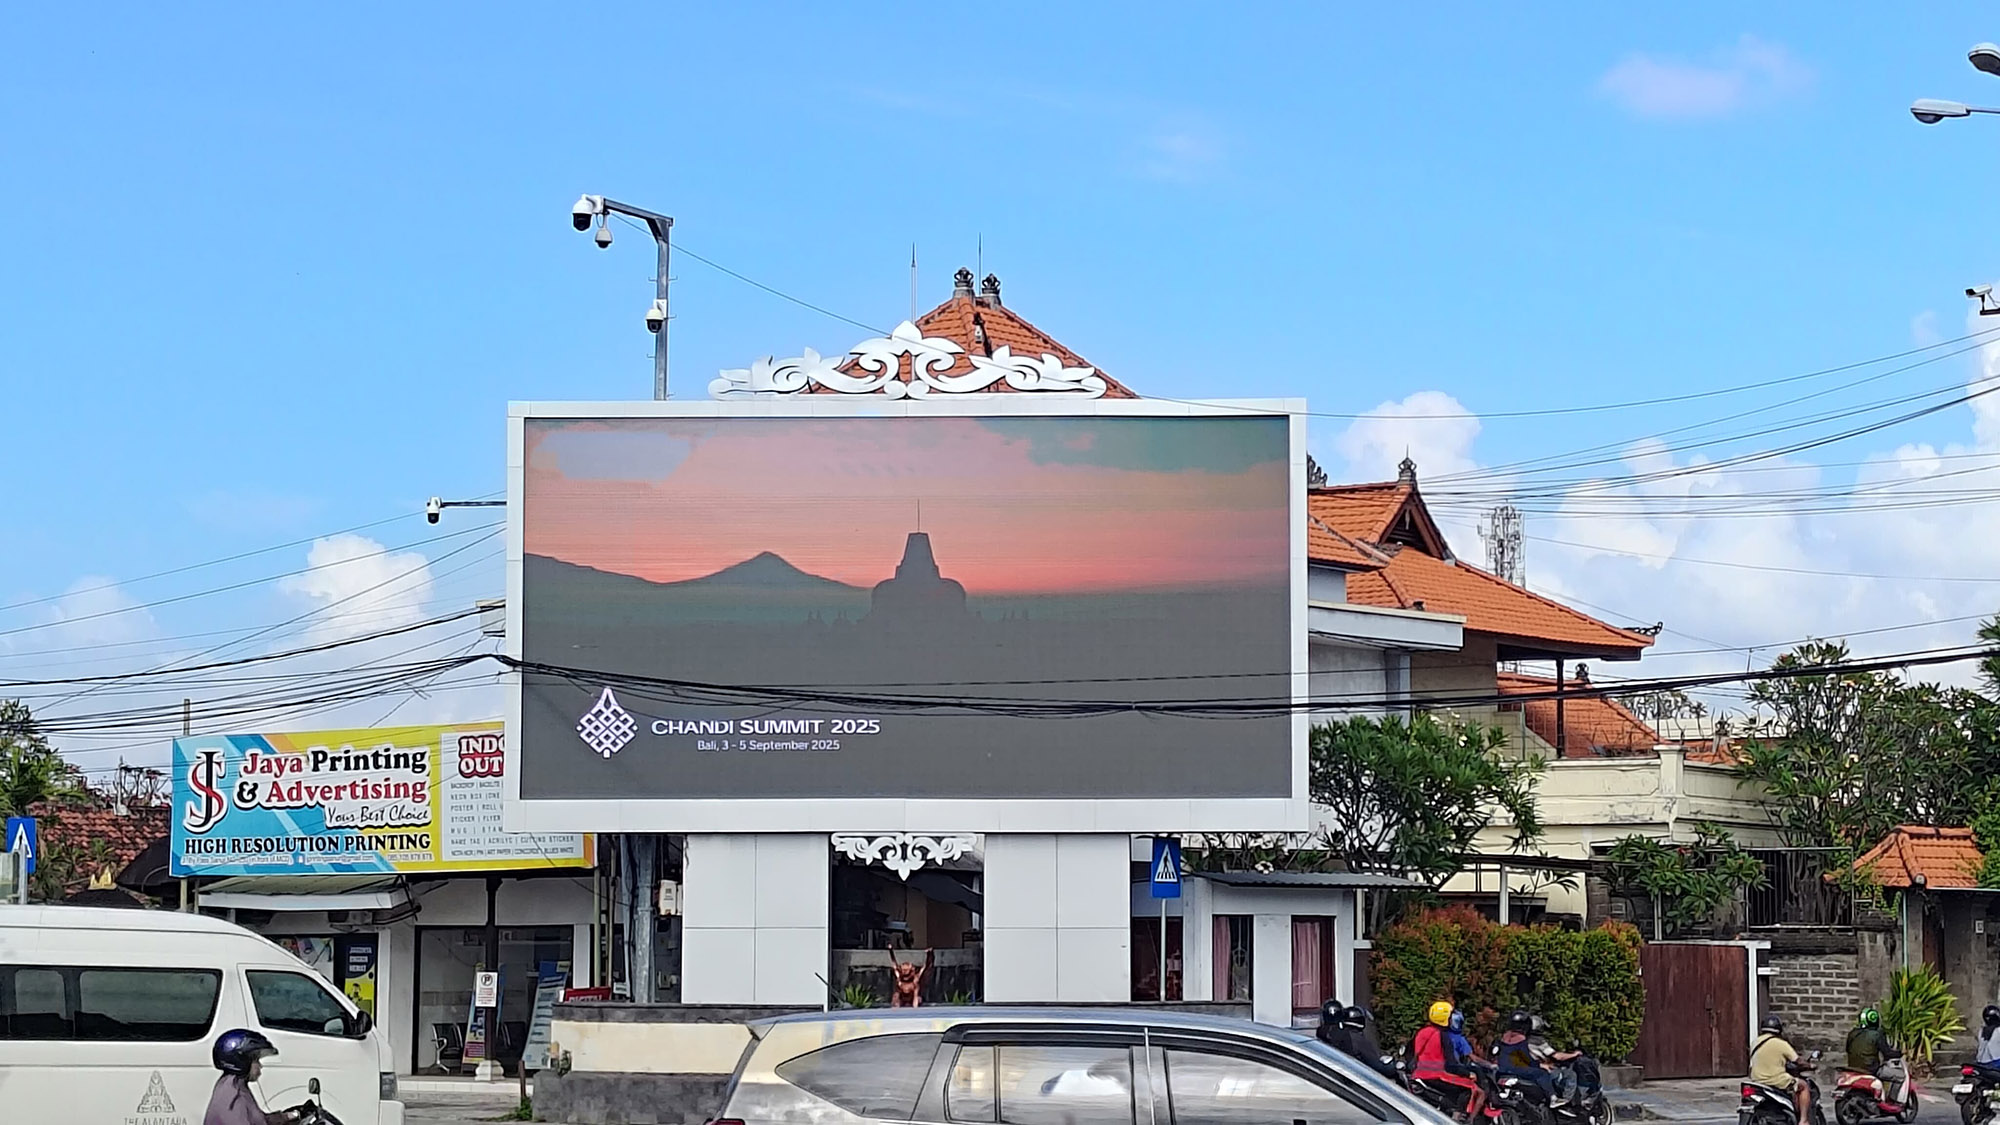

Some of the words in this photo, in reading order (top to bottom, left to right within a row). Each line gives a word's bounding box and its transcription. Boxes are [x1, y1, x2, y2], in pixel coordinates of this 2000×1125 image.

[651, 719, 734, 735] CHANDI
[739, 719, 825, 735] SUMMIT
[830, 719, 881, 735] 2025
[697, 740, 719, 752] Bali,
[721, 740, 729, 750] 3
[739, 740, 747, 750] 5
[748, 740, 809, 753] September
[811, 740, 840, 750] 2025
[243, 752, 303, 778] Jaya
[310, 747, 428, 774] Printing
[237, 781, 259, 803] &
[265, 777, 428, 804] Advertising
[360, 805, 385, 823] Best
[389, 804, 428, 821] Choice
[185, 838, 227, 854] HIGH
[231, 836, 340, 854] RESOLUTION
[344, 833, 431, 851] PRINTING
